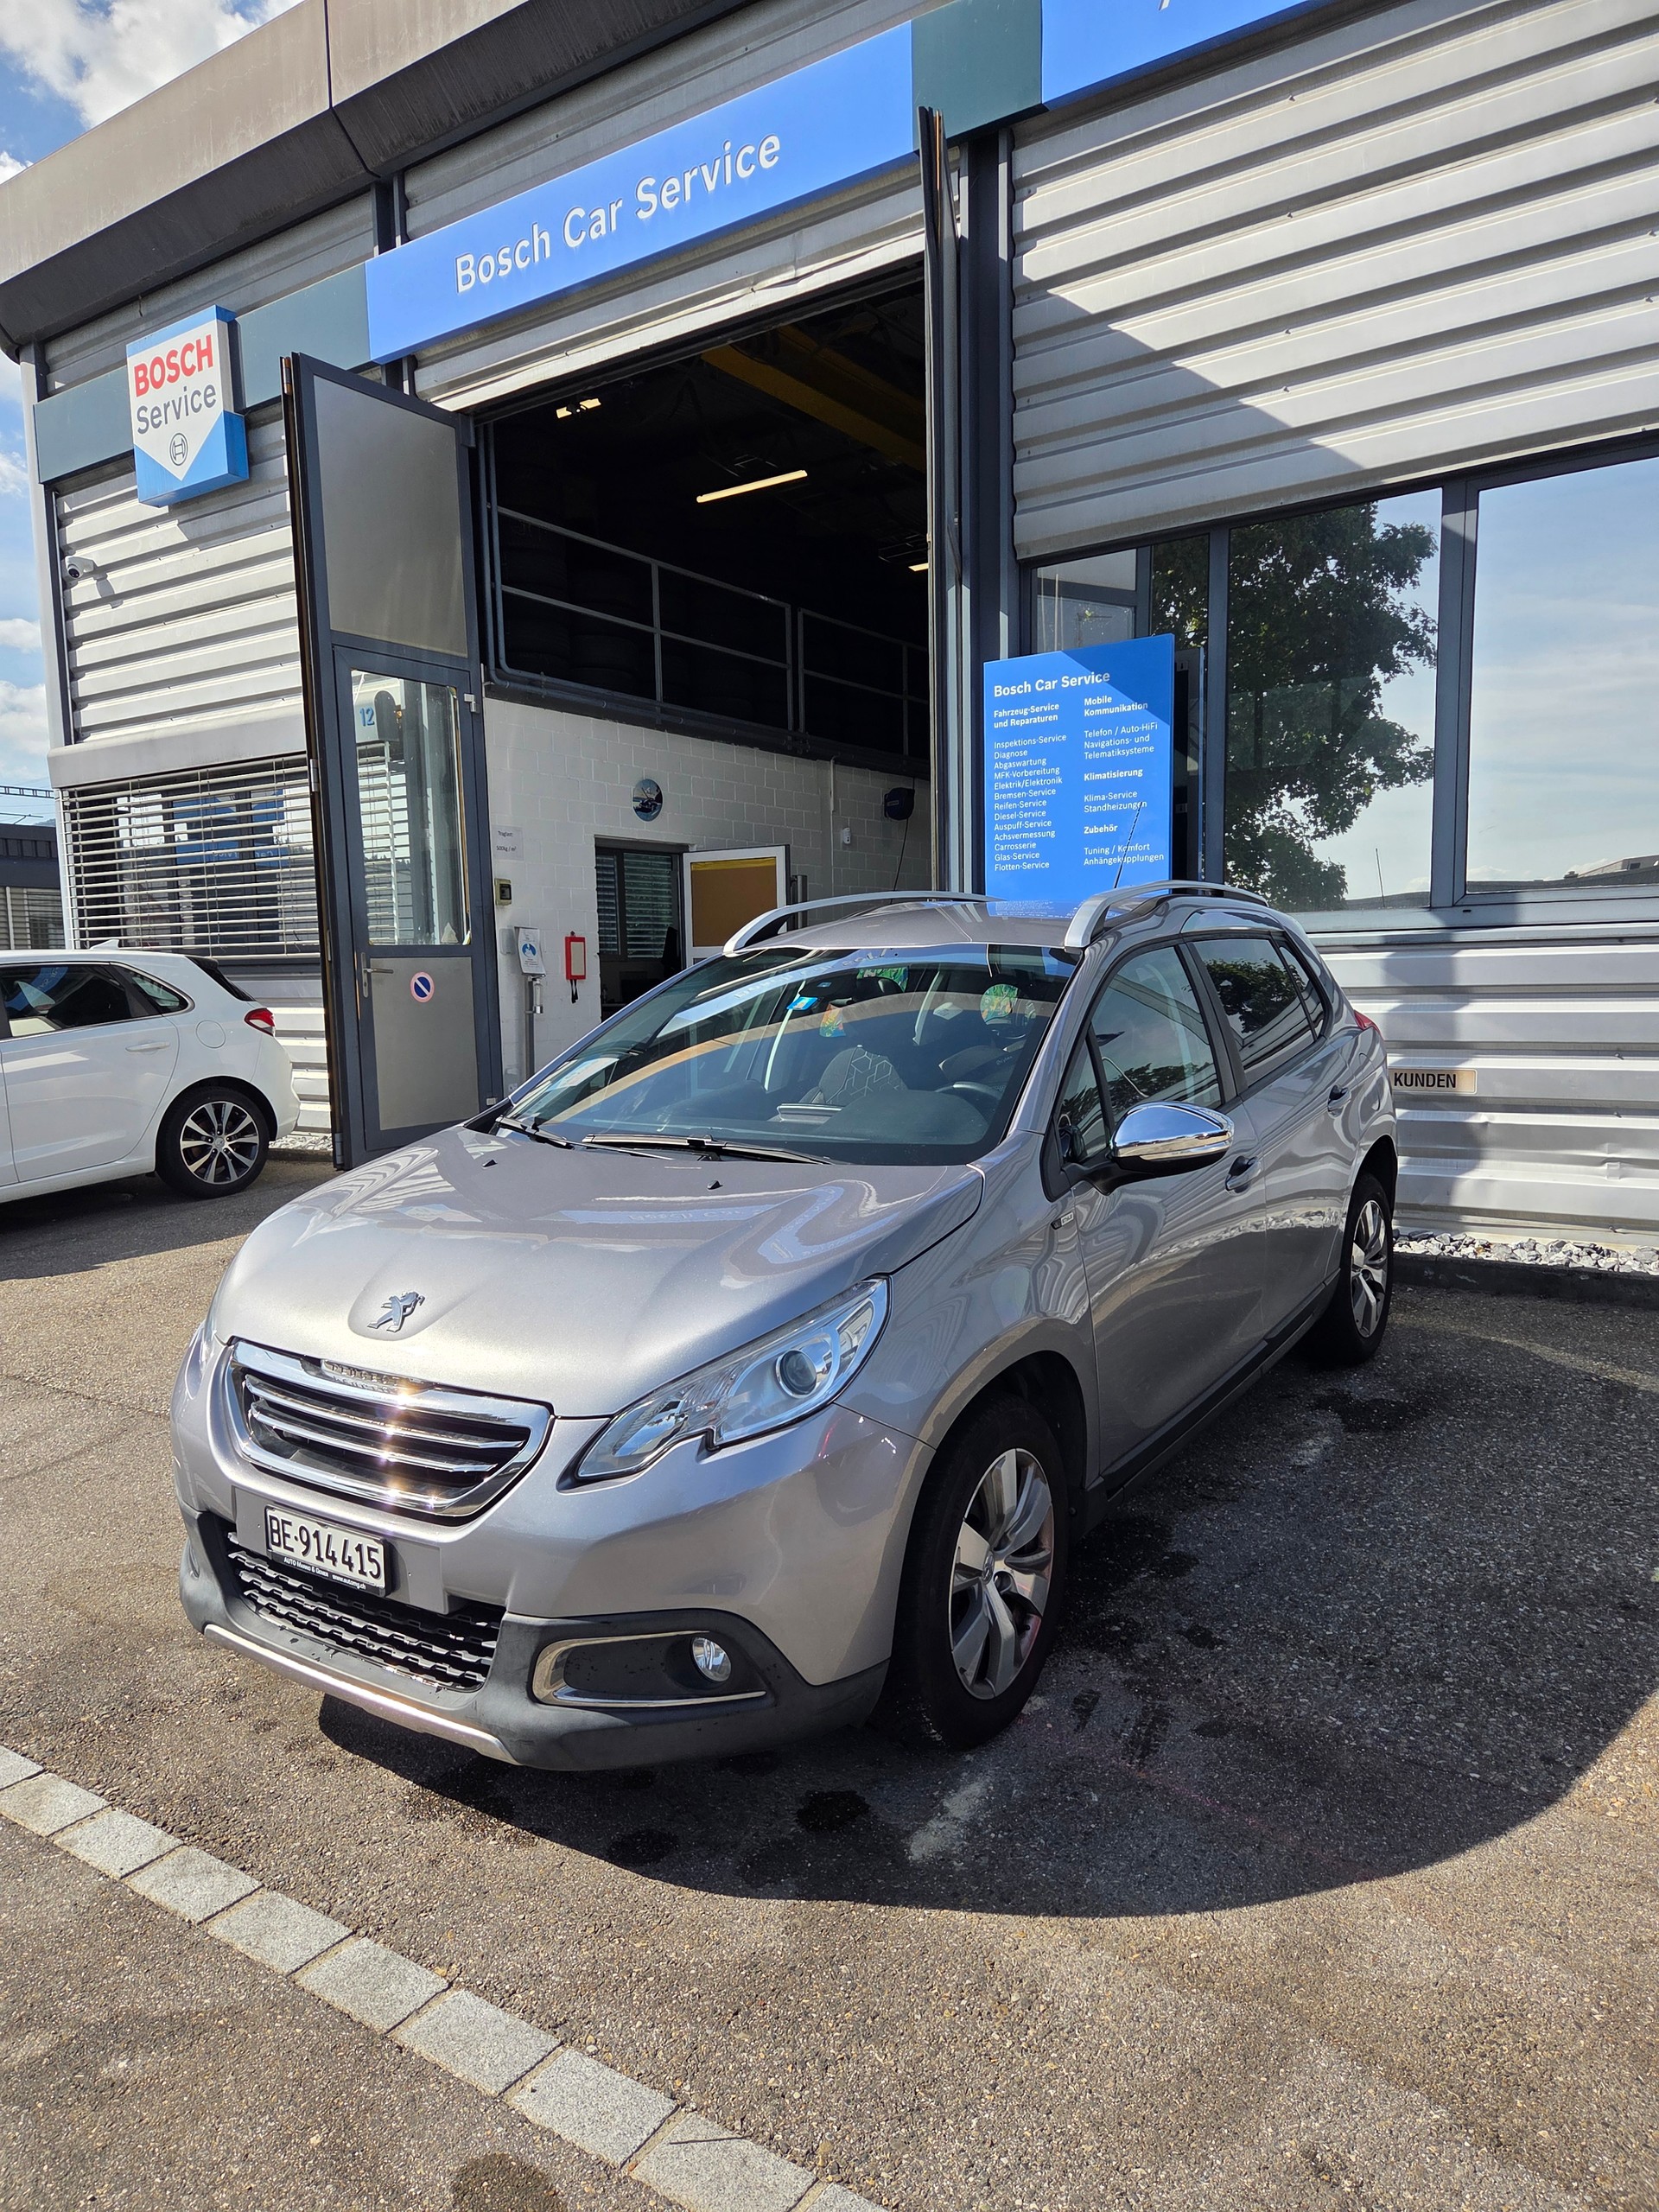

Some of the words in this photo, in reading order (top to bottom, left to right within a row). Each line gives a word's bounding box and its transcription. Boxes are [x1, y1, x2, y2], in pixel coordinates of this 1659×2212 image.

[455, 222, 550, 293] Bosch
[563, 198, 622, 248] Car
[635, 134, 779, 219] Service
[134, 334, 213, 397] BOSCH
[137, 385, 216, 434] Service
[995, 682, 1031, 697] Bosch
[1036, 678, 1058, 691] Car
[1061, 671, 1109, 688] Service
[1084, 696, 1112, 706] Mobile
[995, 703, 1058, 718] Fahrzeug-Service
[1084, 702, 1147, 716] Kommunikation
[359, 707, 375, 727] 12
[995, 719, 1007, 728] und
[1010, 714, 1058, 727] Reparaturen
[1084, 728, 1112, 738] Telefon
[1121, 722, 1158, 734] Auto-HiFi
[995, 734, 1066, 749] Inspektions-Service
[1084, 738, 1132, 749] Navigations-
[1135, 734, 1149, 743] und
[995, 749, 1027, 759] Diagnose
[1084, 746, 1154, 760] Telematiksysteme
[995, 758, 1046, 769] Abgaswartung
[995, 767, 1059, 779] MFK-Vorbereitung
[1084, 768, 1143, 781] Klimatisierung
[995, 777, 1062, 790] Elektrik/Elektronik
[995, 788, 1056, 799] Bremsen-Service
[1084, 791, 1137, 802] Klima-Service
[995, 799, 1046, 810] Reifen-Service
[1084, 800, 1147, 813] Standheizungen
[995, 810, 1046, 820] Diesel-Service
[995, 820, 1052, 830] Auspuff-Service
[1084, 824, 1117, 834] Zubehör
[995, 830, 1055, 841] Achsvermessung
[995, 841, 1036, 851] Carrosserie
[1084, 846, 1109, 855] Tuning
[1118, 843, 1149, 852] Komfort
[995, 851, 1039, 861] Glas-Service
[1084, 853, 1164, 865] Anhängekupplungen
[995, 861, 1049, 871] Flotten-Service
[1394, 1072, 1457, 1088] KUNDEN
[333, 1363, 400, 1386] PEUGEOT
